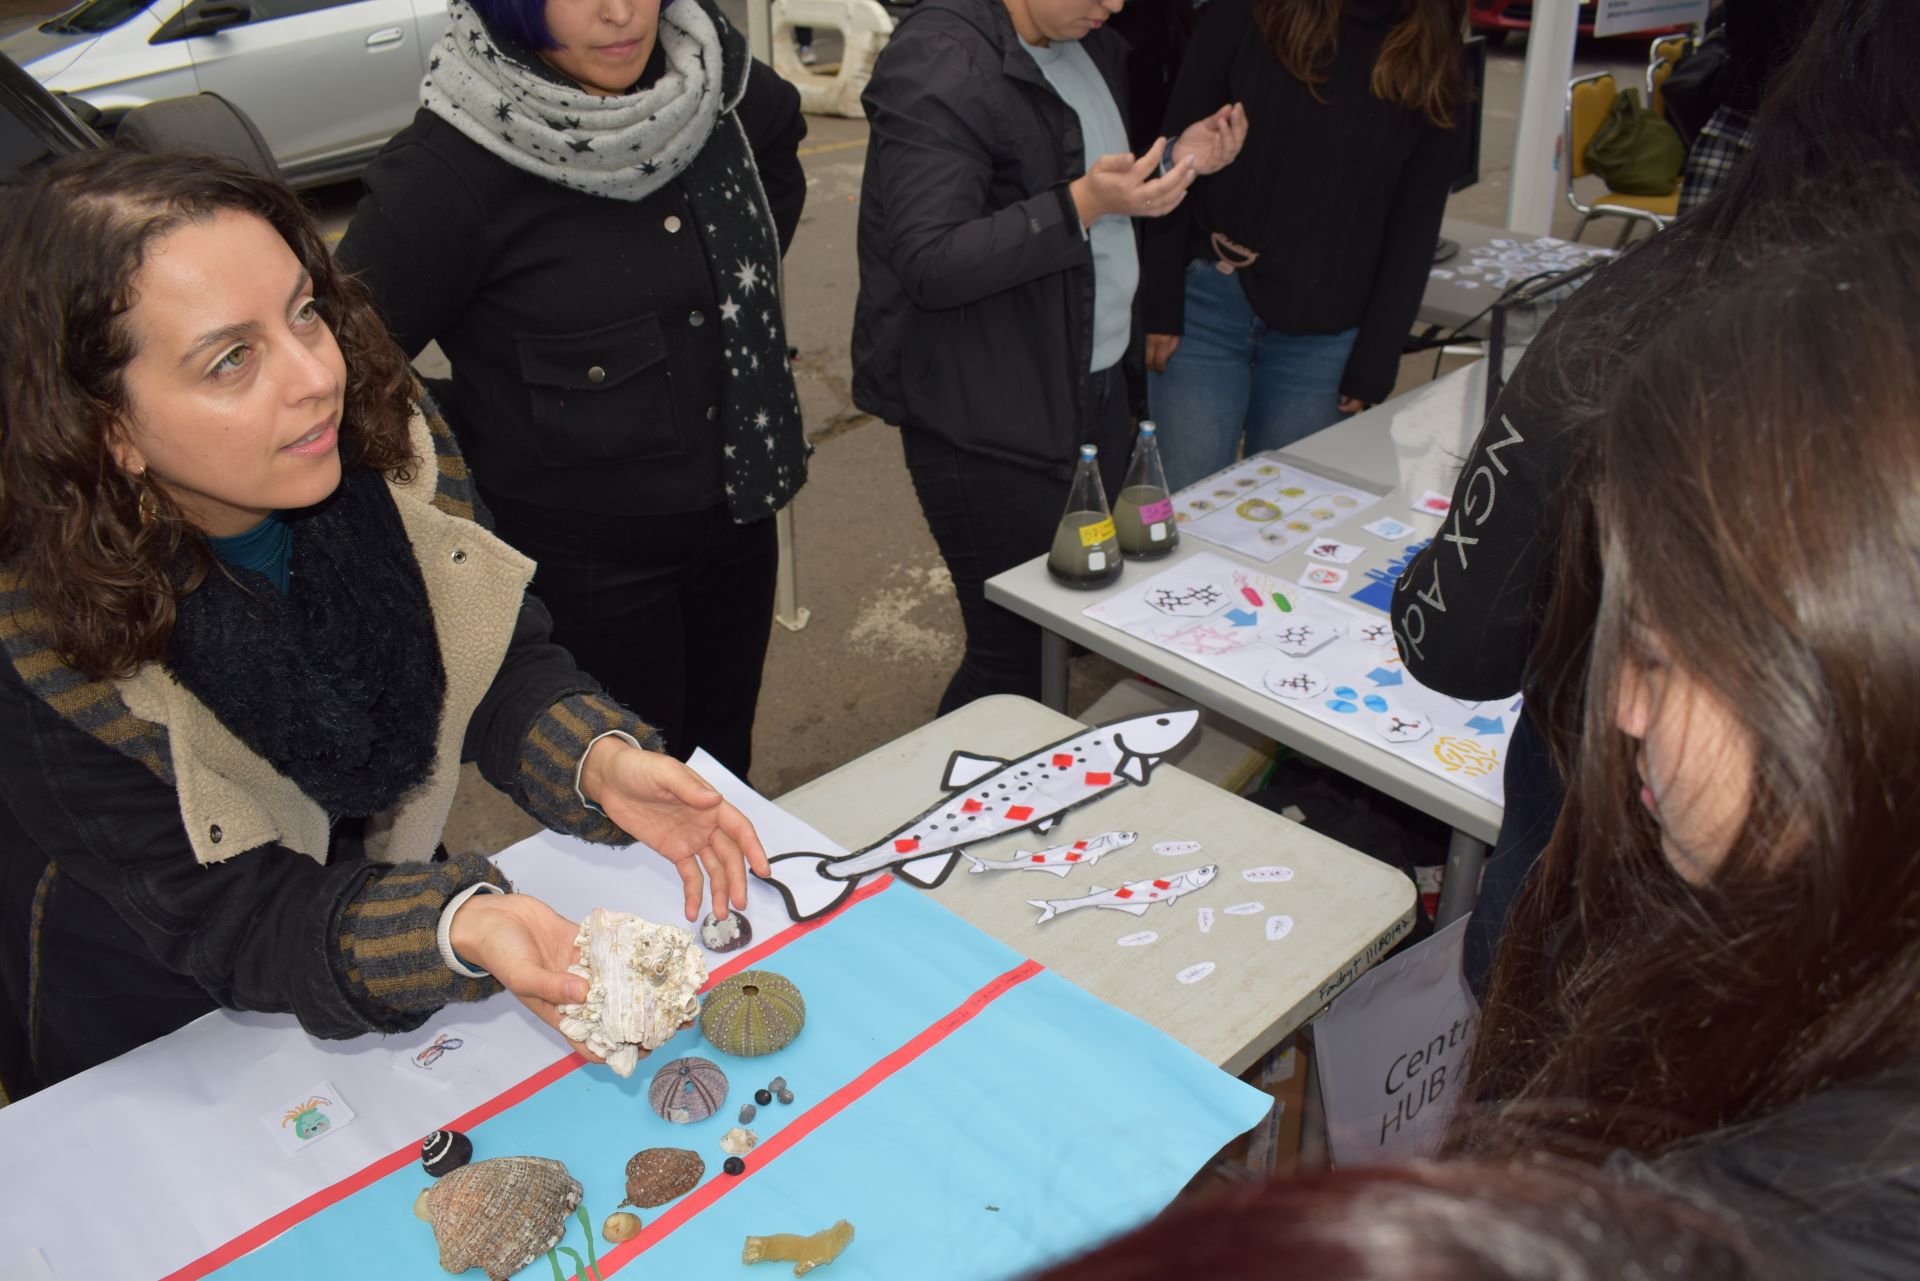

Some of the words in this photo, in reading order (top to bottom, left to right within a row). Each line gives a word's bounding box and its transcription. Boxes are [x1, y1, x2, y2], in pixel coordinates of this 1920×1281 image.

[1443, 412, 1525, 571] NGX
[1384, 1013, 1476, 1096] Centr
[1380, 1065, 1447, 1147] HUB
